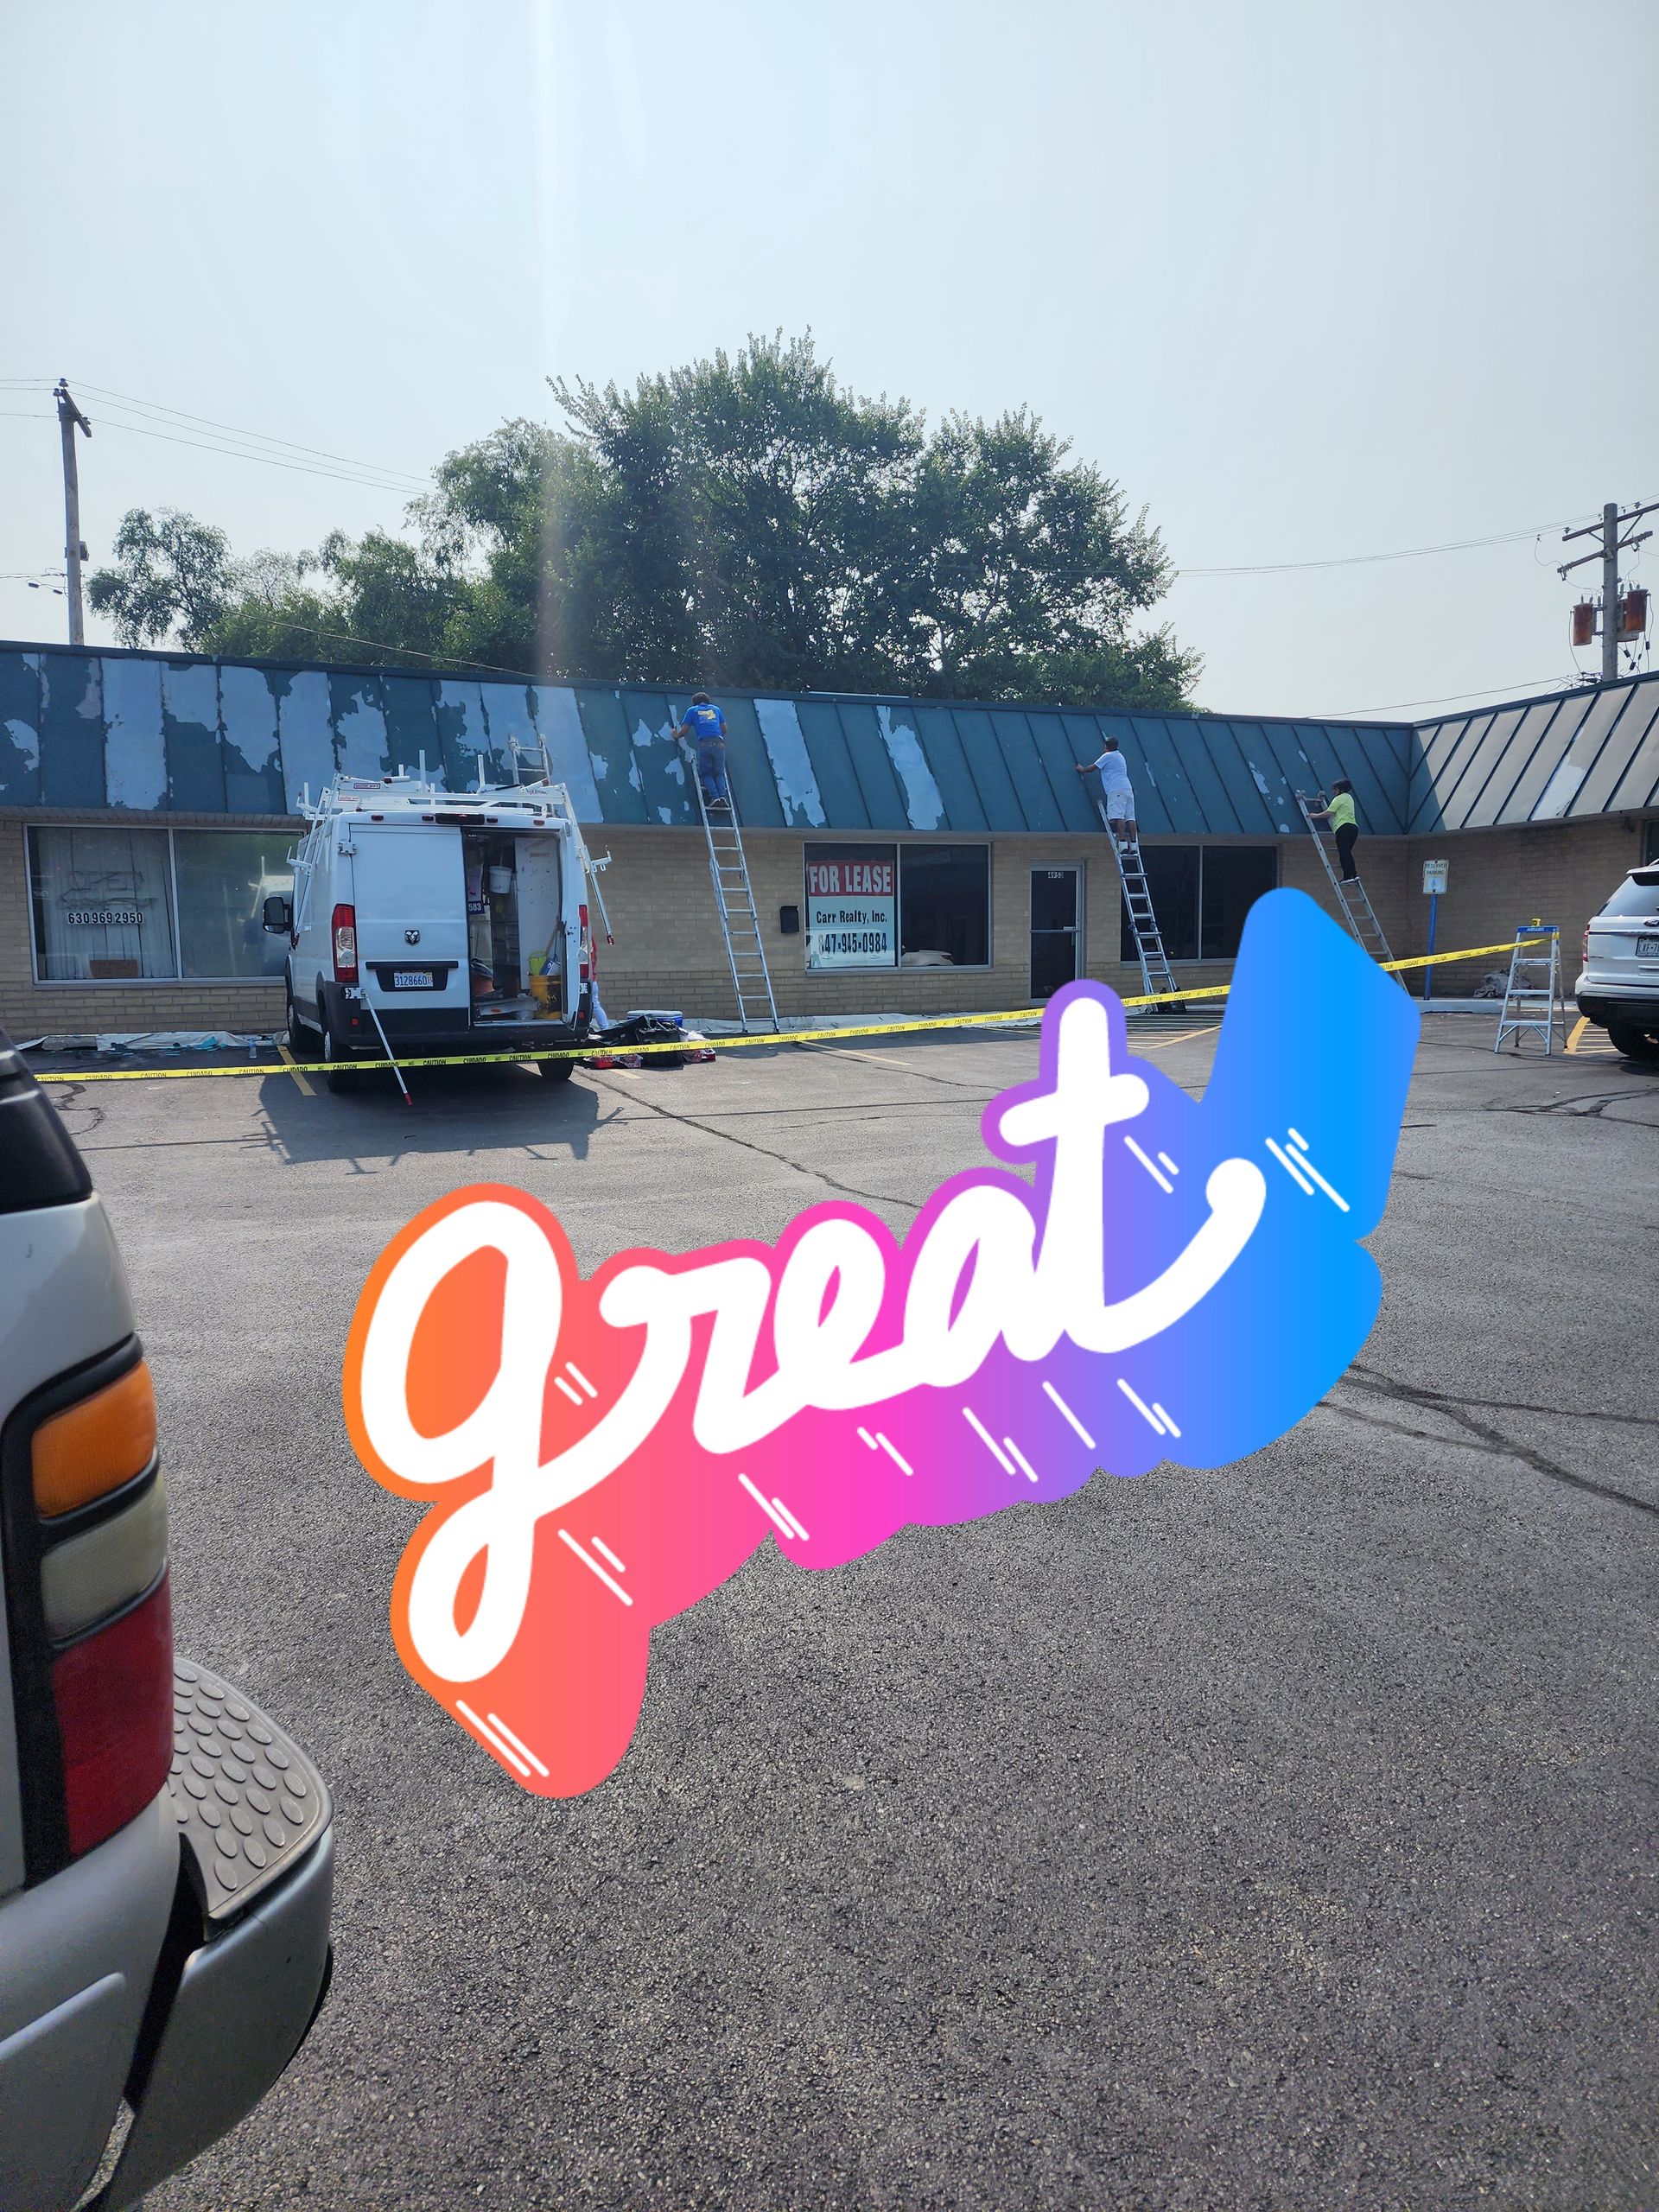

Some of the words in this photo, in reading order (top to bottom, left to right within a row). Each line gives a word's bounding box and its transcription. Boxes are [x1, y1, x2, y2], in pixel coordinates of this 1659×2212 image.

[809, 865, 840, 893] FOR
[844, 865, 891, 893] LEASE
[68, 912, 89, 924] 630
[92, 912, 113, 924] 969
[115, 912, 143, 924] 2950
[817, 911, 836, 924] Carr
[839, 910, 869, 925] Realty,
[872, 910, 887, 923] Inc.
[818, 932, 887, 955] 847-945-0984
